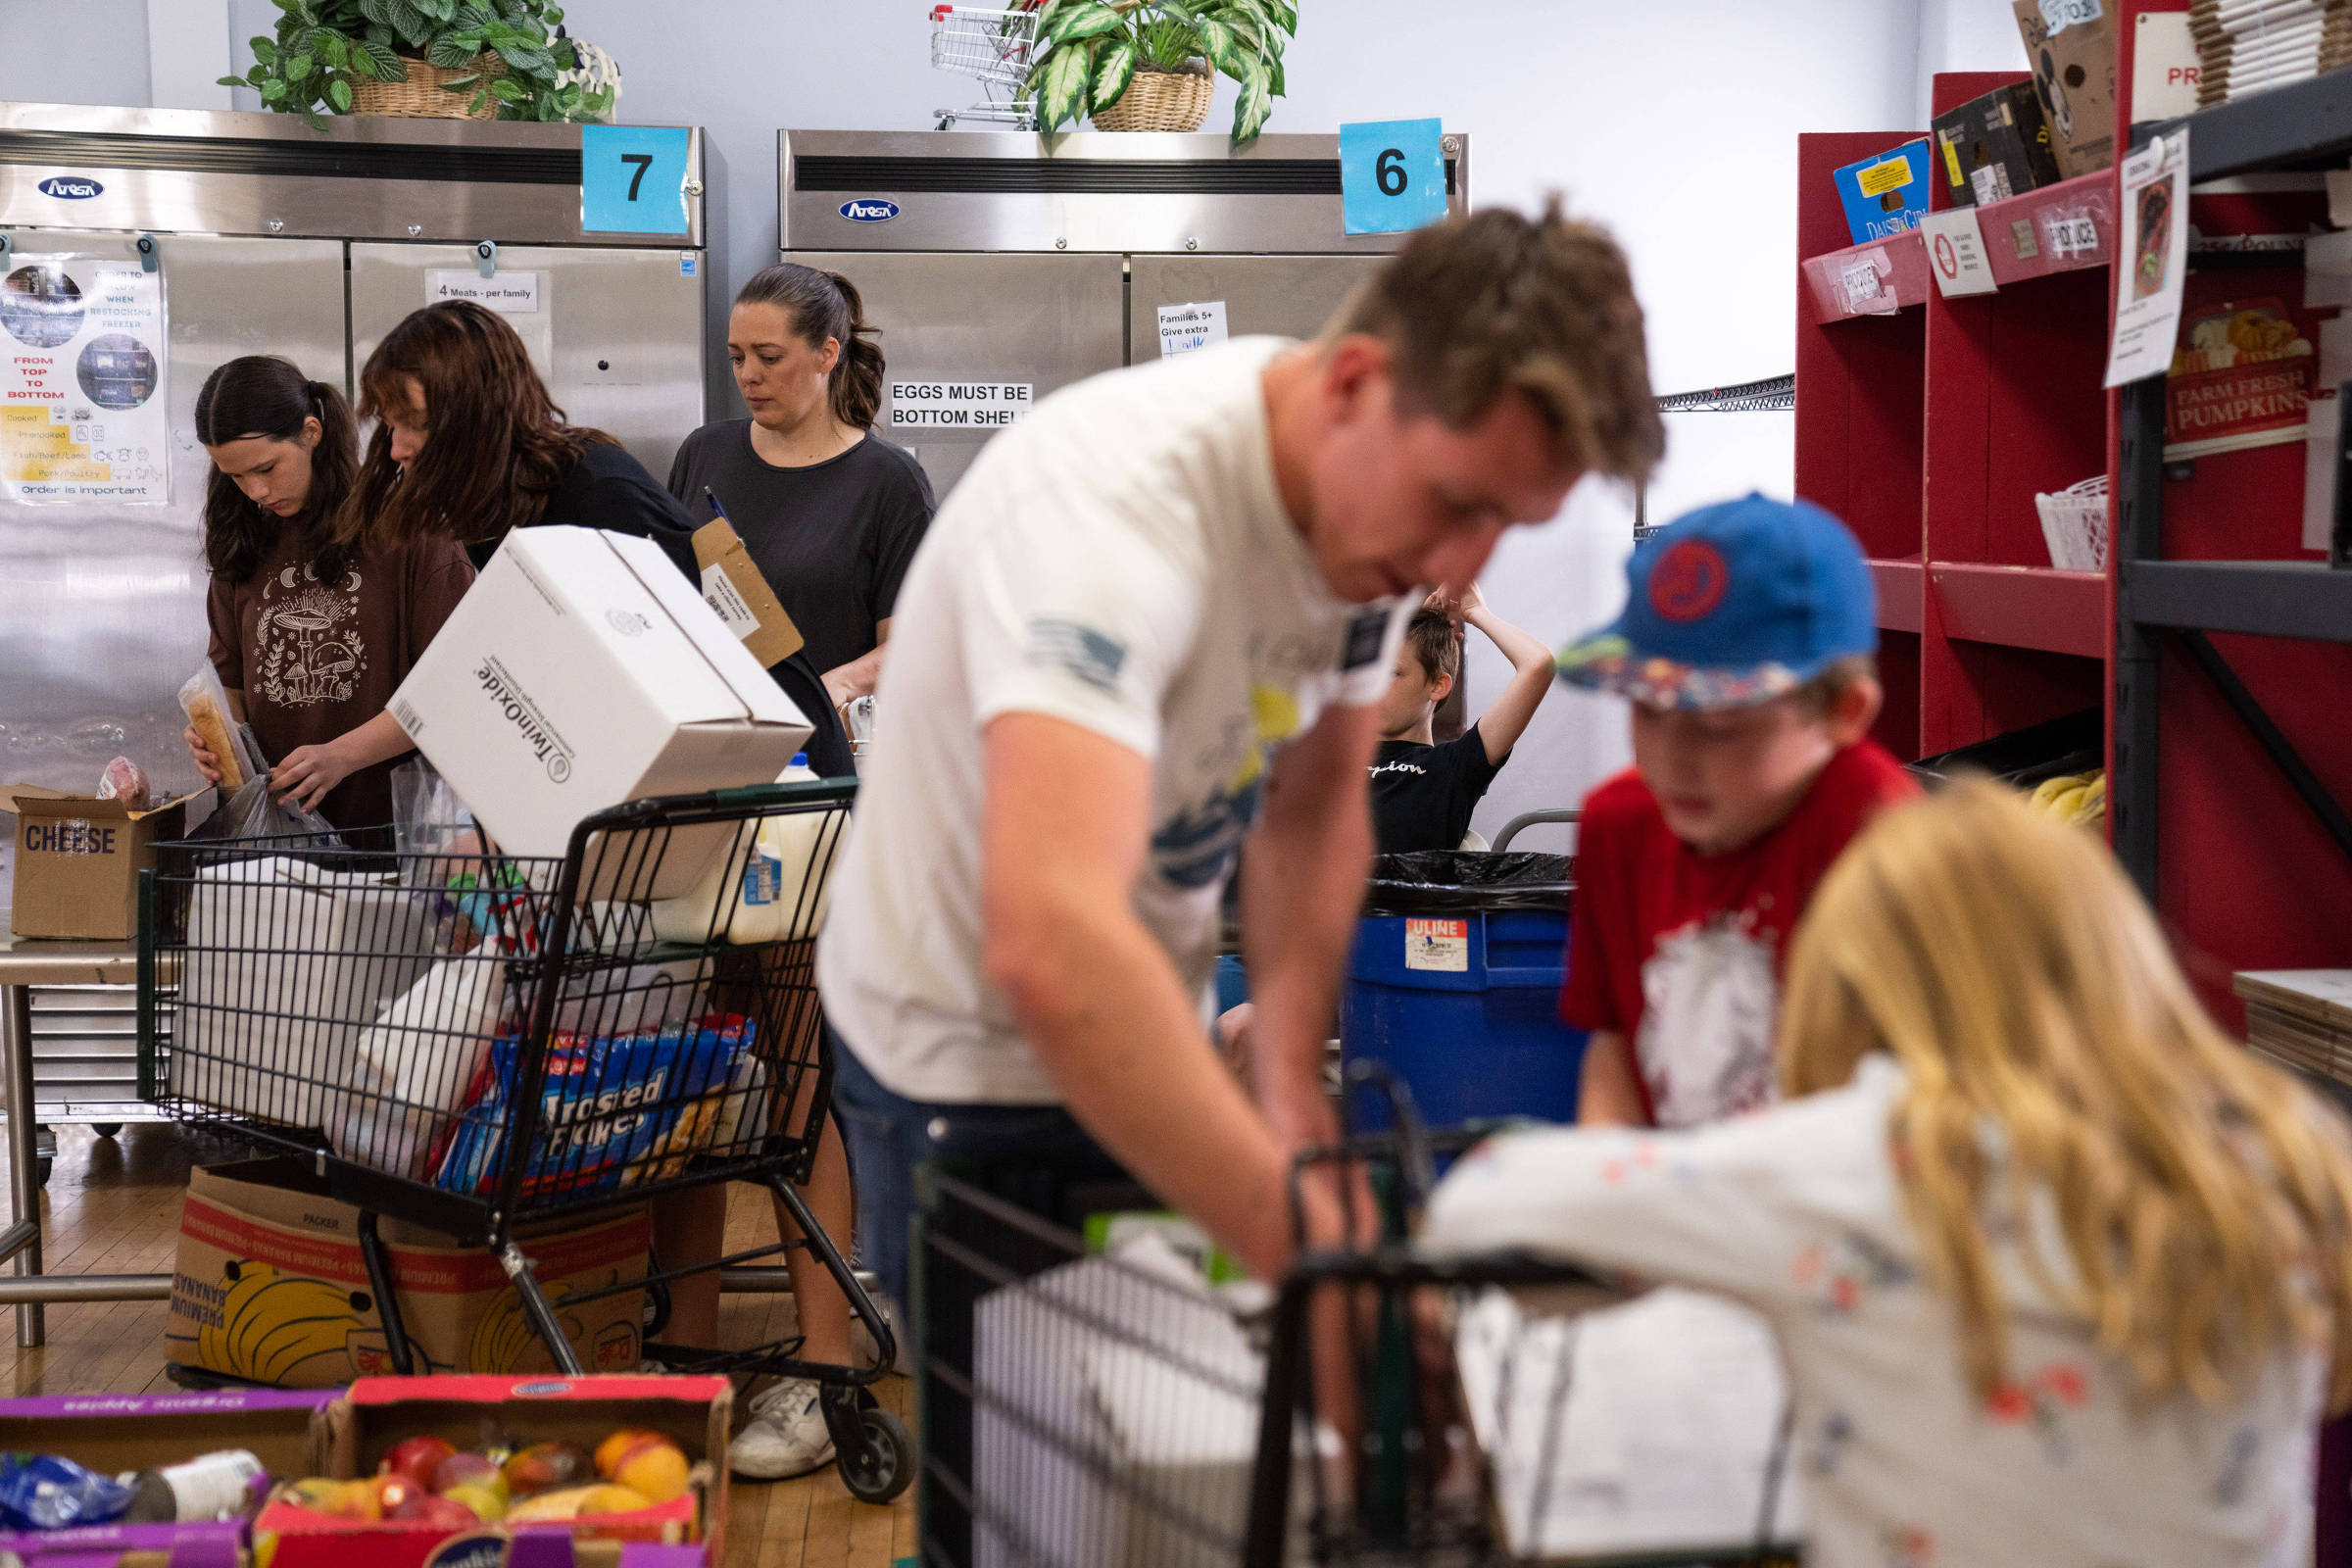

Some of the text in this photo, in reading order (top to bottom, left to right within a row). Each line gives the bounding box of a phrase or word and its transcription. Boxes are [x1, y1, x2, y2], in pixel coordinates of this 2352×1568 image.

[2168, 68, 2199, 85] PR
[621, 154, 653, 202] 7
[1376, 148, 1407, 196] 6
[439, 284, 447, 296] 4
[451, 288, 477, 297] Meats
[486, 289, 501, 298] per
[503, 289, 530, 299] family
[90, 308, 152, 317] RESTOCKING
[1160, 314, 1199, 323] Families
[1185, 325, 1208, 334] extra
[893, 385, 1027, 400] EGGS MUST BE
[2178, 370, 2304, 405] FARM FRESH
[893, 409, 967, 423] BOTTOM
[2179, 390, 2309, 429] PUMPKINS
[79, 486, 147, 496] important
[476, 666, 554, 762] TwinOxide
[1366, 761, 1426, 778] pion
[25, 825, 116, 855] CHEESE
[1414, 920, 1457, 935] ULINE
[303, 1214, 339, 1230] PACKER
[173, 1272, 226, 1308] BANANAS
[171, 1295, 225, 1330] PREMIUM
